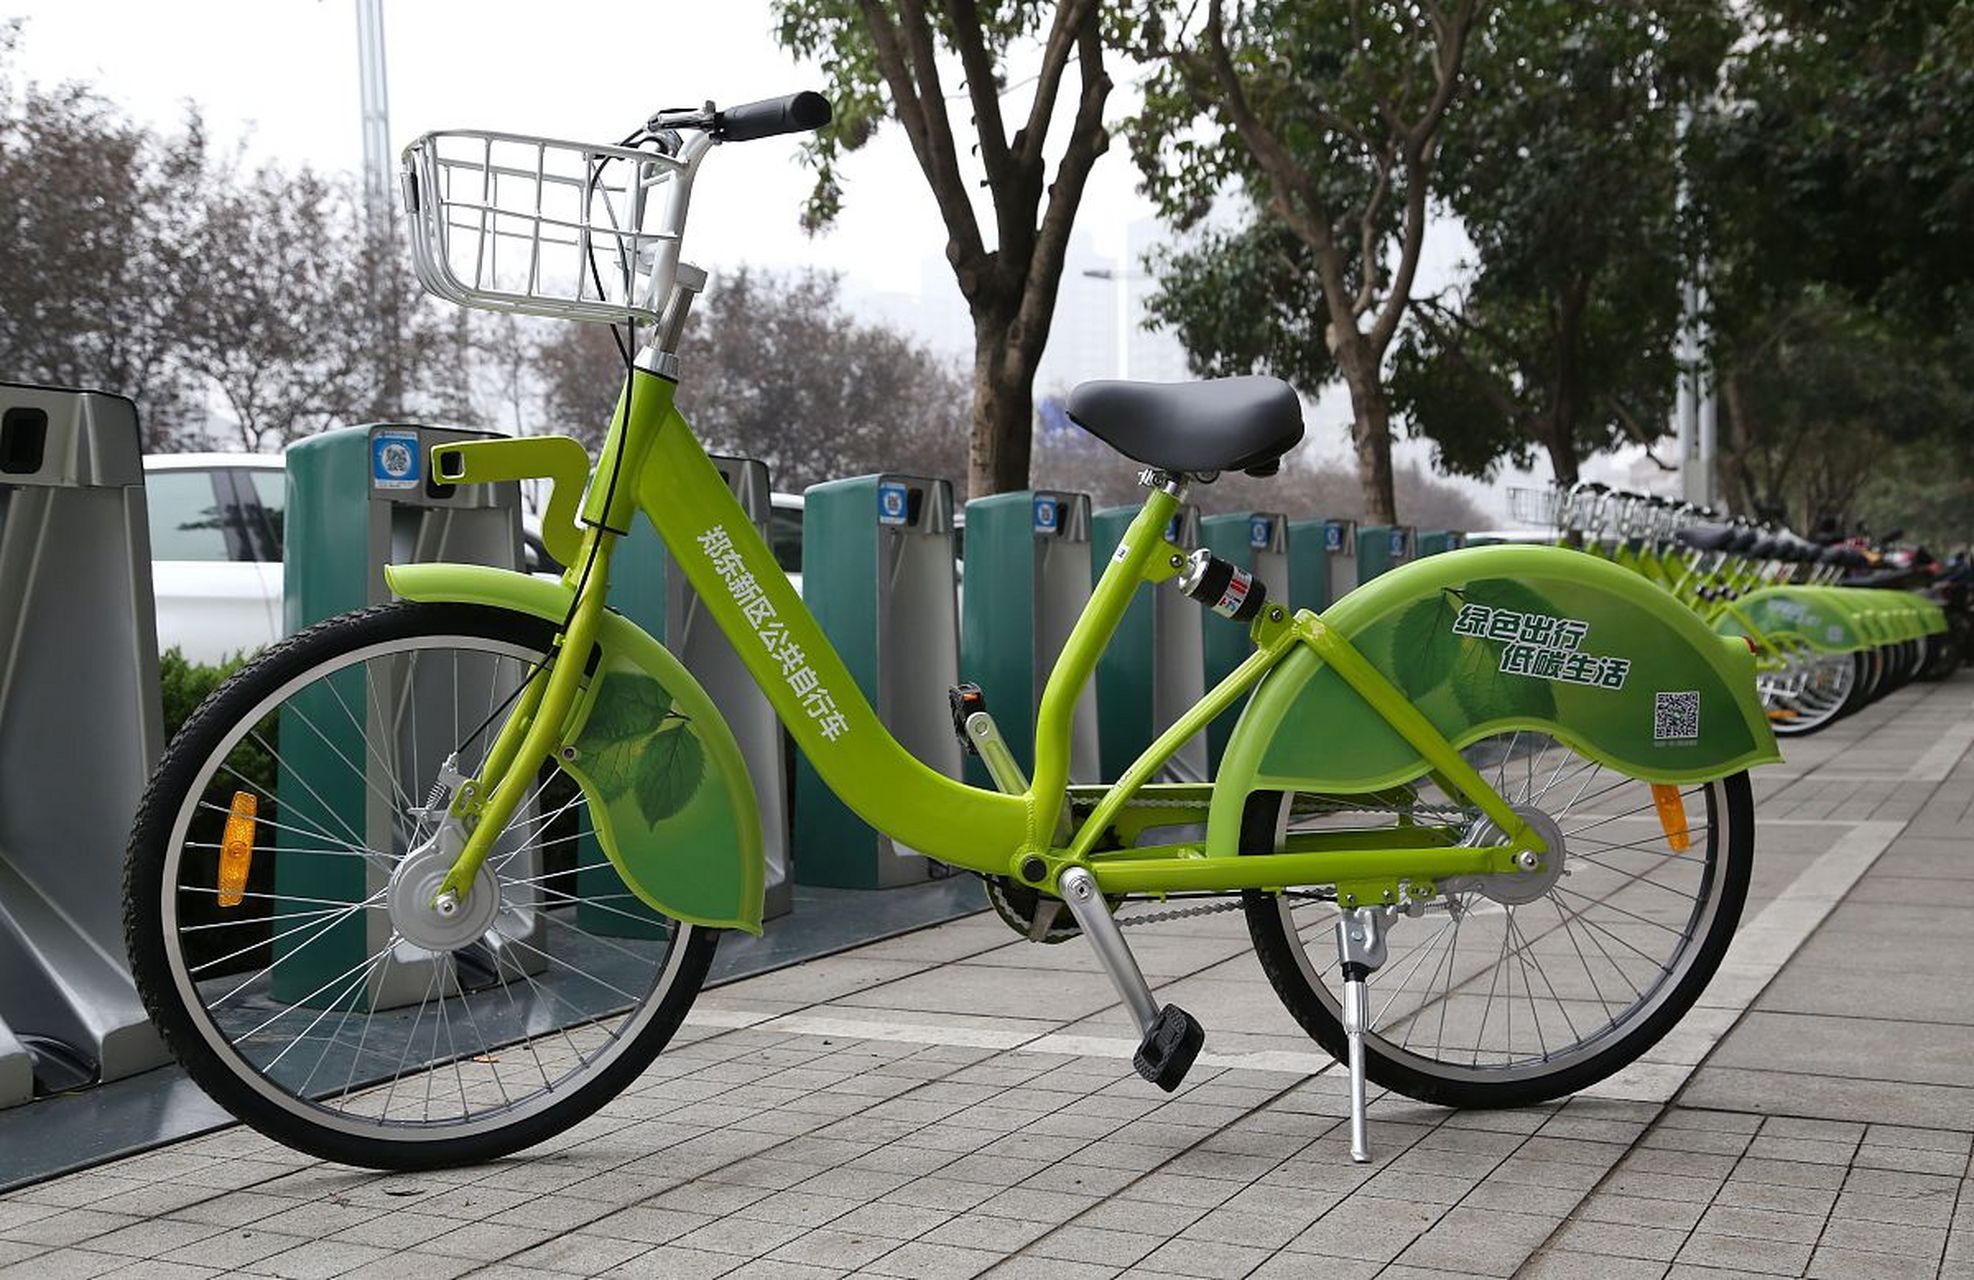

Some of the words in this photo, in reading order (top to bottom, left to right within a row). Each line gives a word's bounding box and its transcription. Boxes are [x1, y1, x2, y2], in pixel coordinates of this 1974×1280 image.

[697, 525, 849, 742] 郑东新区公共自行车
[1453, 603, 1588, 650] 绿色出行
[1500, 641, 1630, 690] 低碳生活
